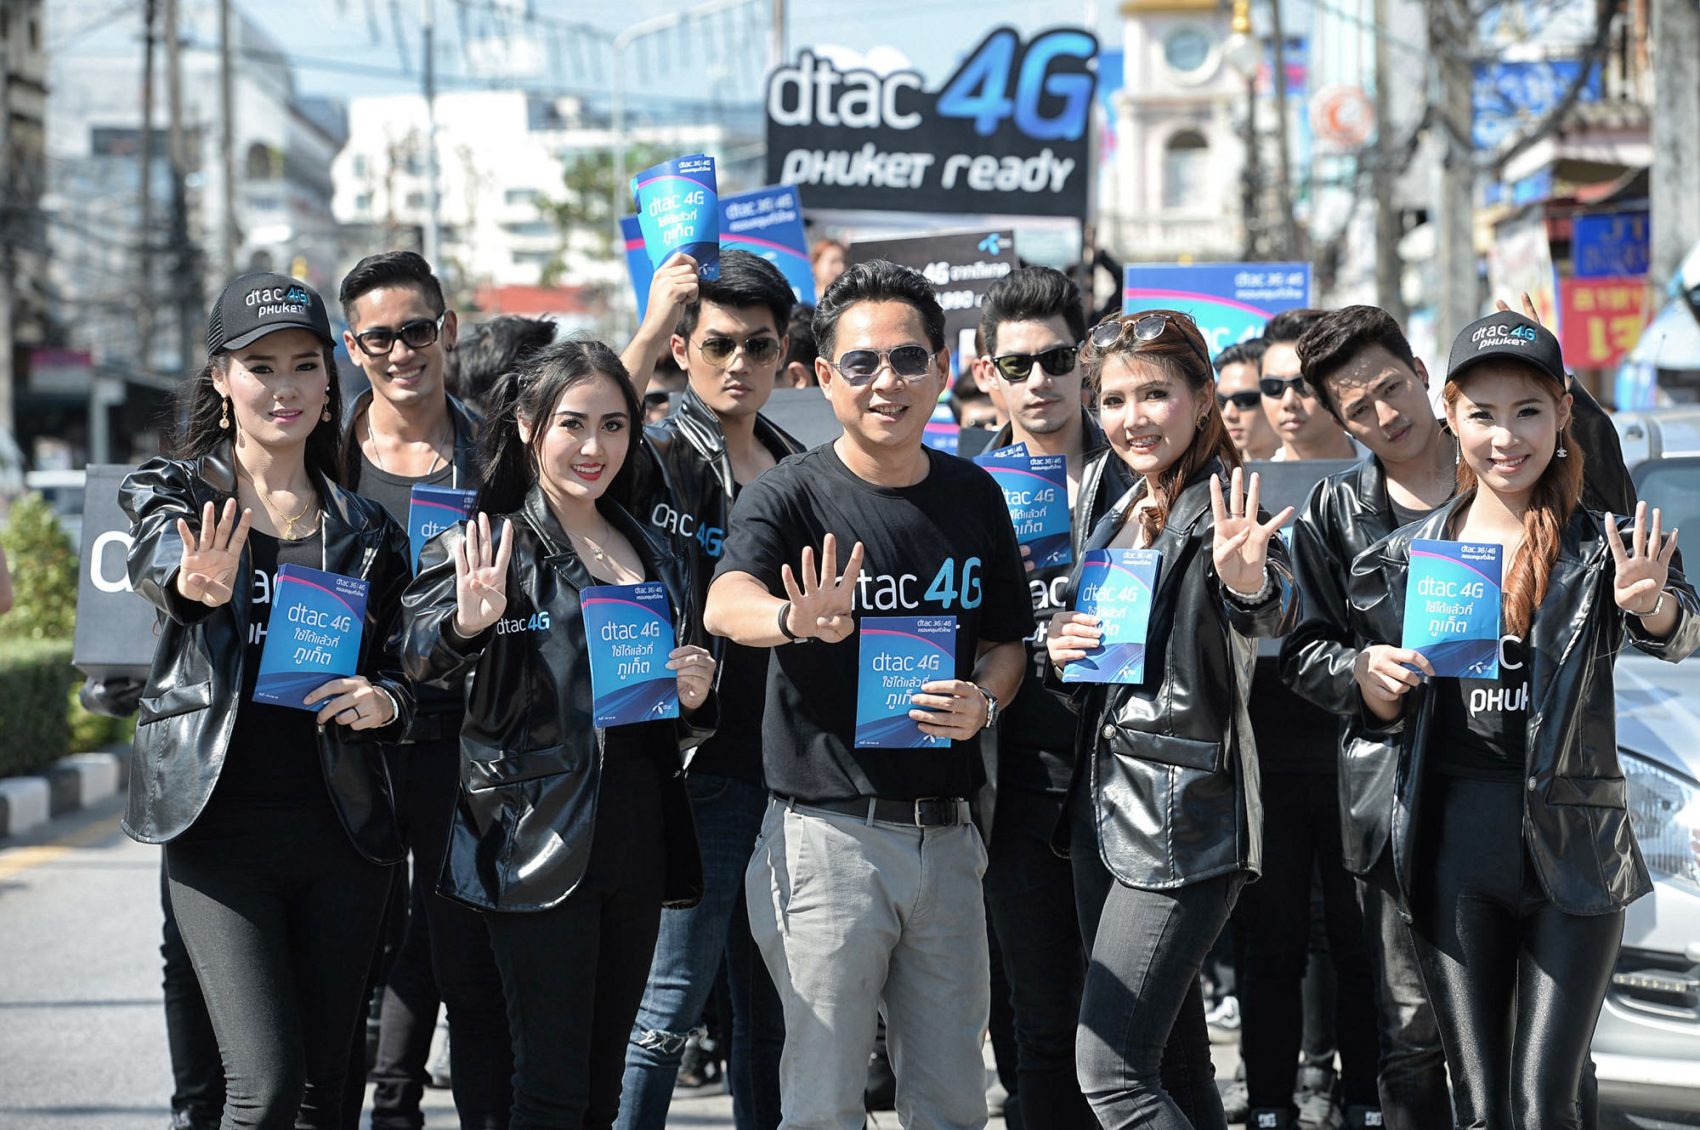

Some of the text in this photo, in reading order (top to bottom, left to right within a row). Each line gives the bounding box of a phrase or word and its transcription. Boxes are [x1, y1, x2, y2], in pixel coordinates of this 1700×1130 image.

[768, 29, 1096, 142] dtac 4G
[649, 190, 704, 217] dtac 4G
[246, 286, 309, 306] dtac 4G
[1472, 324, 1537, 342] dtac 4G
[1033, 488, 1055, 503] 4G
[696, 521, 724, 557] 4G
[924, 557, 983, 609] 4G
[1083, 582, 1139, 602] dtac 4G
[1417, 576, 1484, 599] dtac 4G
[287, 602, 351, 633] dtac 4G
[496, 611, 550, 635] dtac 4G
[917, 619, 932, 627] dtac
[1428, 616, 1467, 637] ภูเก็ต
[601, 620, 659, 641] dtac 4G
[293, 646, 332, 665] ภูเก็ต
[872, 652, 940, 671] dtac 4G
[617, 657, 650, 680] ภูเก็ต
[885, 688, 914, 710] ภูเก็
